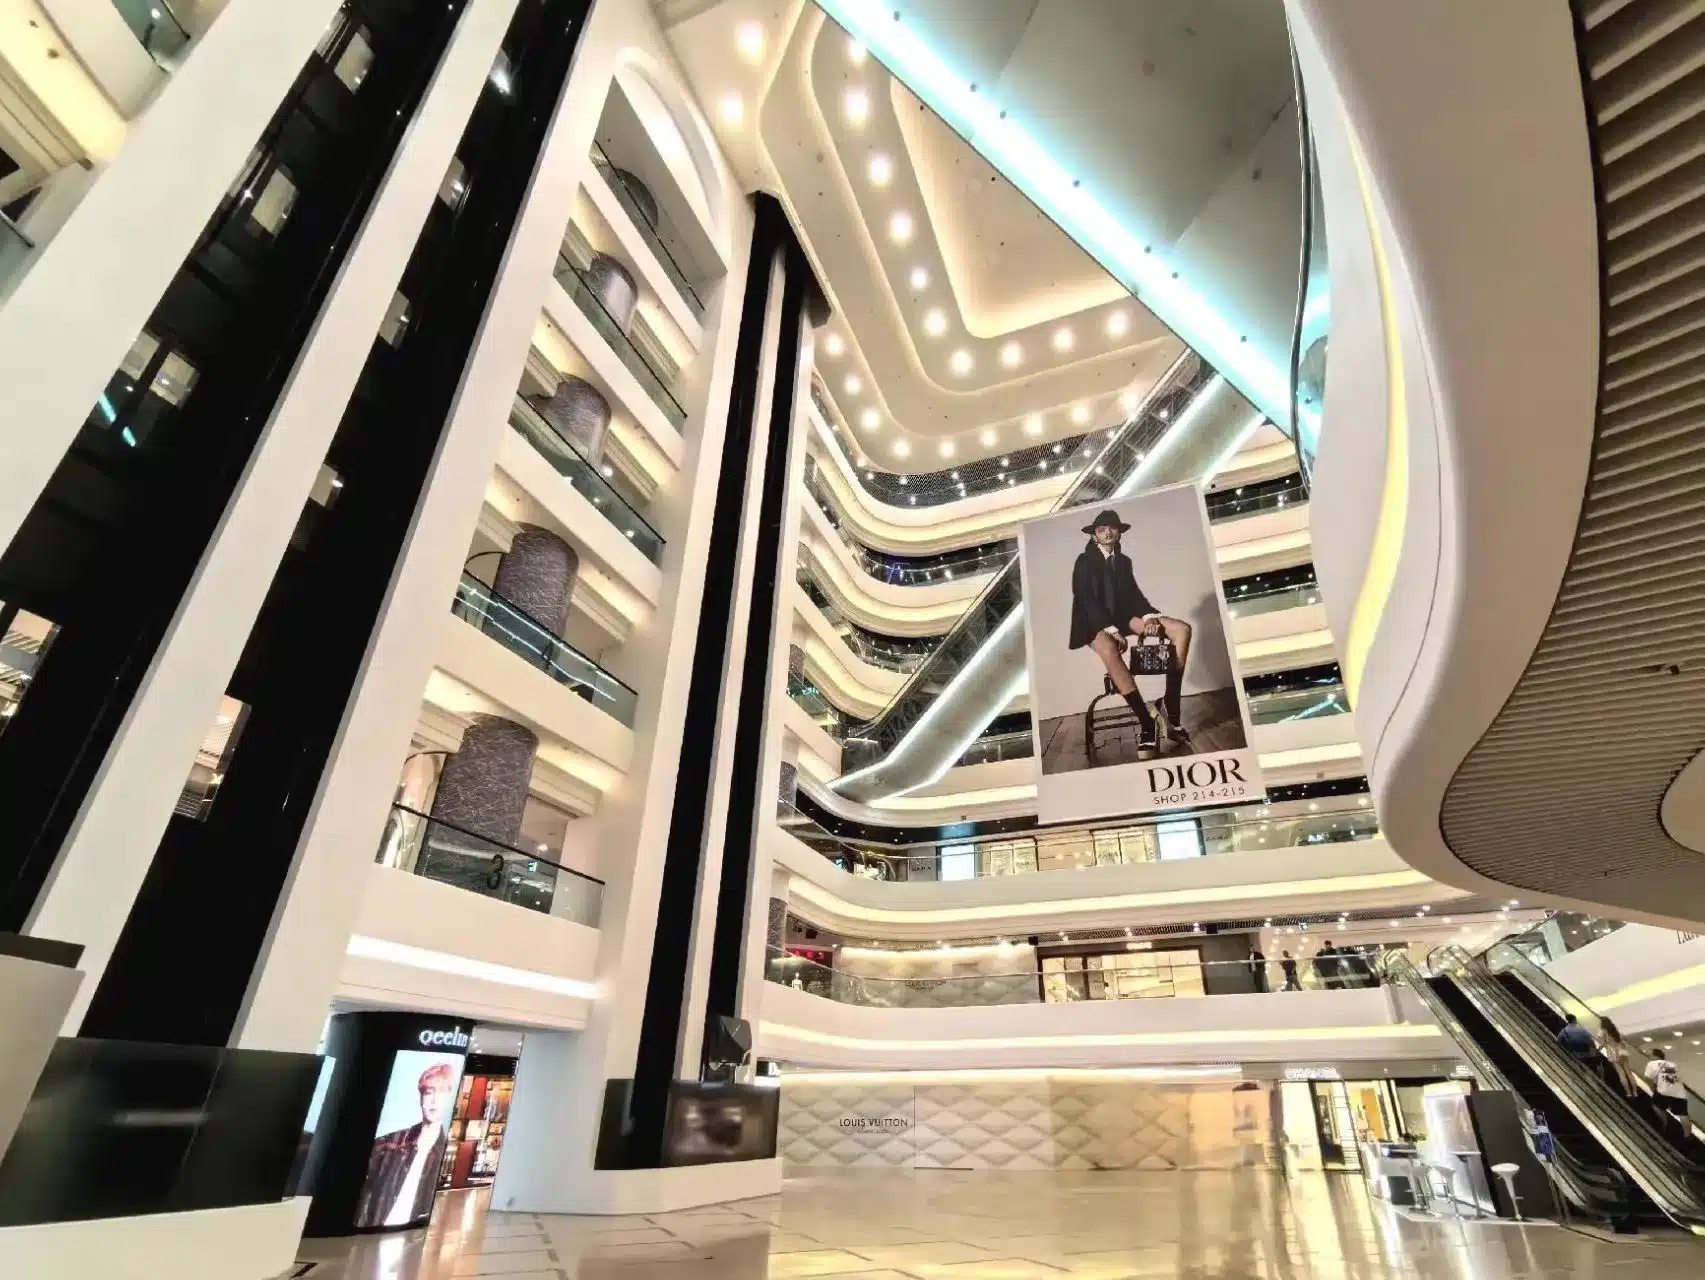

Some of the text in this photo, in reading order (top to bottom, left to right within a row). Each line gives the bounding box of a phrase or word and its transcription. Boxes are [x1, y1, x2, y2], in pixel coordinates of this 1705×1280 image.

[1146, 758, 1248, 792] DIOR
[1153, 786, 1245, 805] SHOP 214-215
[839, 1118, 908, 1127] LOUIS VUITTON
